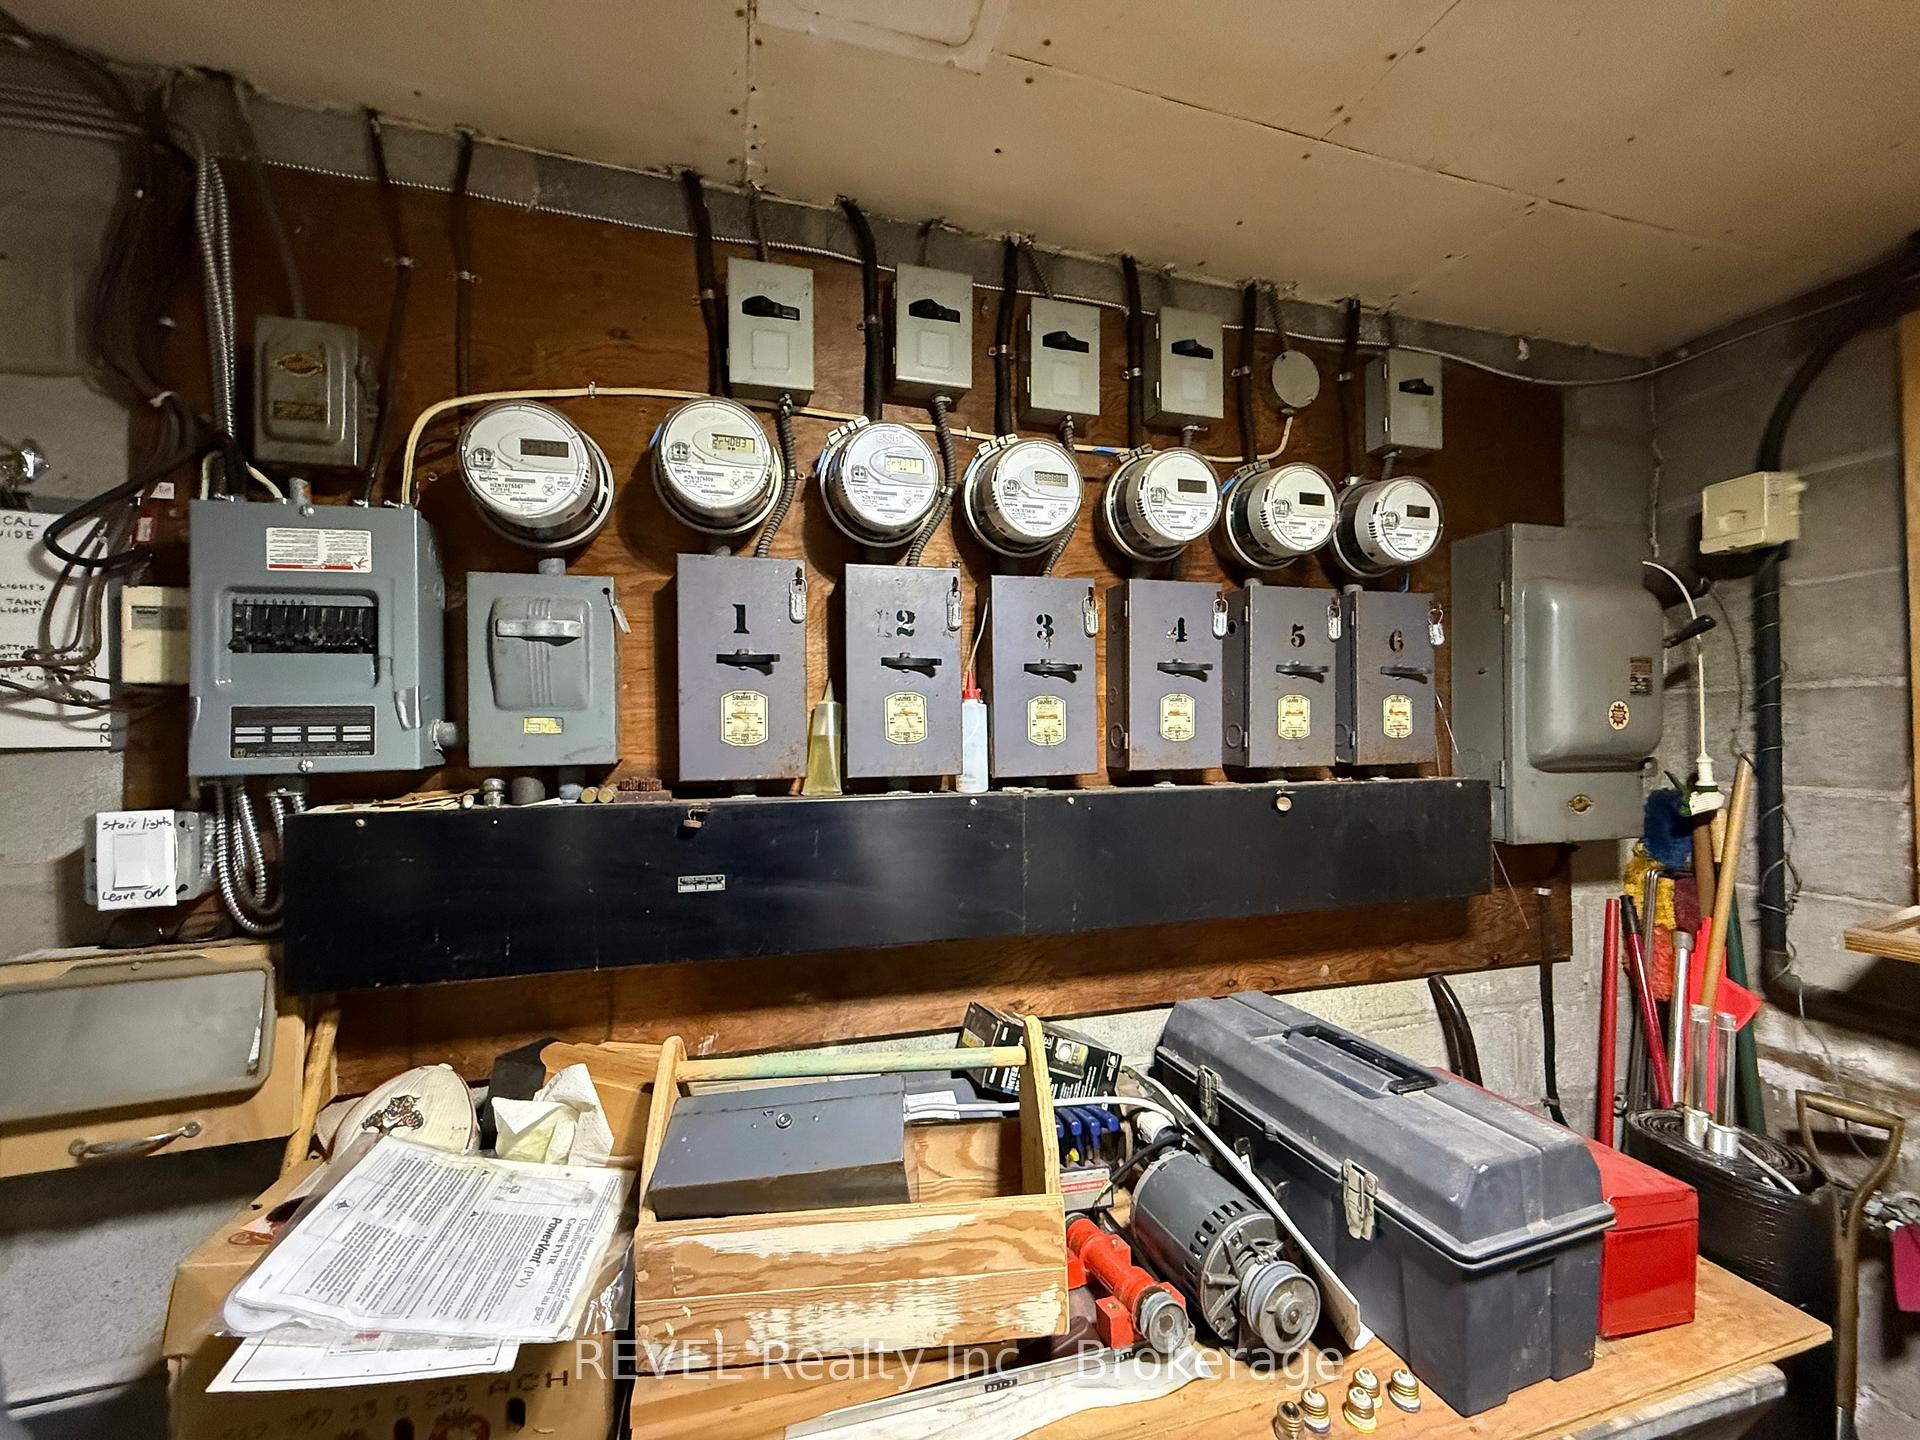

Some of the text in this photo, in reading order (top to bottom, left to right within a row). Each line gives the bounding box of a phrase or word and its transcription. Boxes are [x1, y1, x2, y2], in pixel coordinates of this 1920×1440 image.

[733, 604, 750, 634] 1
[896, 610, 915, 637] 2
[1036, 614, 1054, 639] 3
[1291, 624, 1305, 648] 5
[1389, 630, 1404, 652] 6
[142, 816, 172, 830] lights
[514, 1266, 536, 1287] (PV)
[541, 1295, 550, 1305] au
[533, 1306, 545, 1321] gaz
